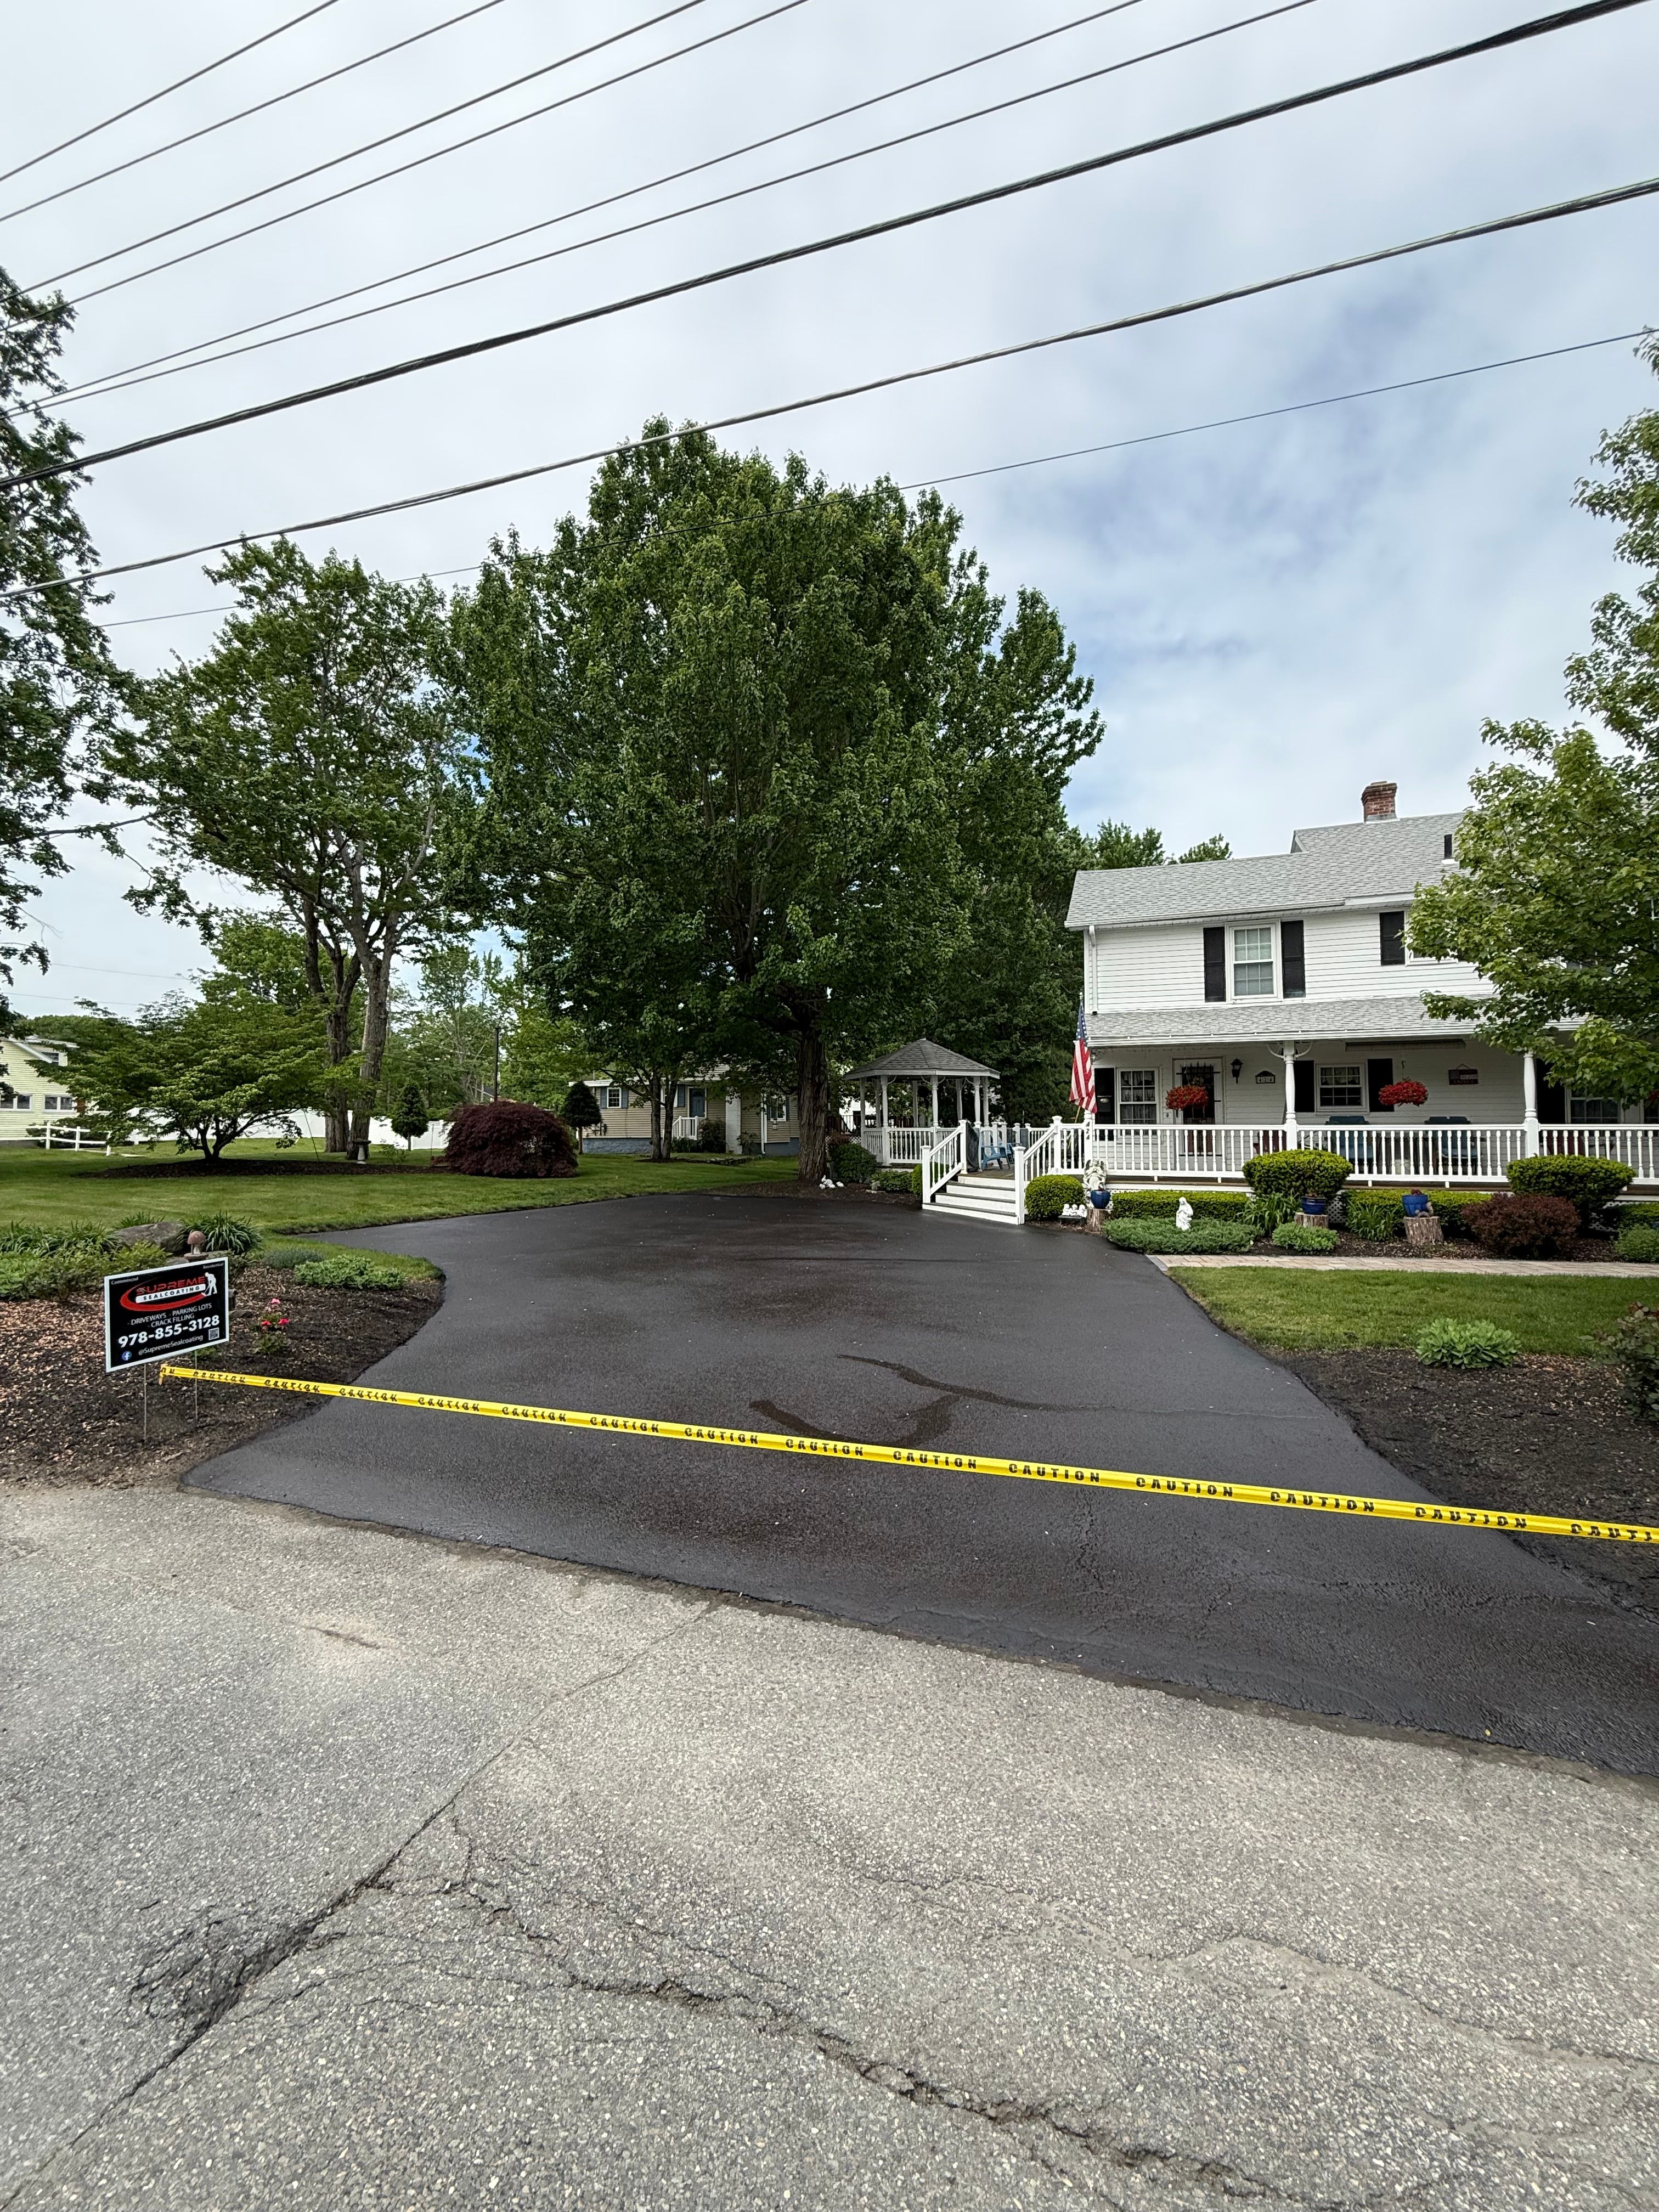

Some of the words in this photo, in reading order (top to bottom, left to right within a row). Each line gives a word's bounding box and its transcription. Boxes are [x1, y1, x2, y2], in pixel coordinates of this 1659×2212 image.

[111, 1277, 139, 1285] Commercial
[136, 1276, 206, 1295] SUPREME
[143, 1286, 200, 1301] SEALCOATING
[131, 1312, 167, 1325] DRIVEWAYS
[172, 1306, 198, 1316] PARKING
[198, 1302, 212, 1311] LOTS
[151, 1318, 172, 1328] CRACK
[172, 1313, 195, 1323] FILLING
[118, 1314, 219, 1348] 978-855-3128
[138, 1335, 204, 1356] @SupremeSealcoating
[417, 1397, 480, 1412] CAUTION
[501, 1406, 566, 1422] CAUTION
[590, 1417, 659, 1433] CAUTION
[684, 1427, 758, 1444] CAUTION
[785, 1438, 864, 1457] CAUTION
[893, 1451, 977, 1469] CAUTION
[1008, 1463, 1100, 1483] CAUTION
[1136, 1477, 1233, 1497] CAUTION
[1270, 1491, 1375, 1513] CAUTION
[1415, 1507, 1527, 1528] CAUTION
